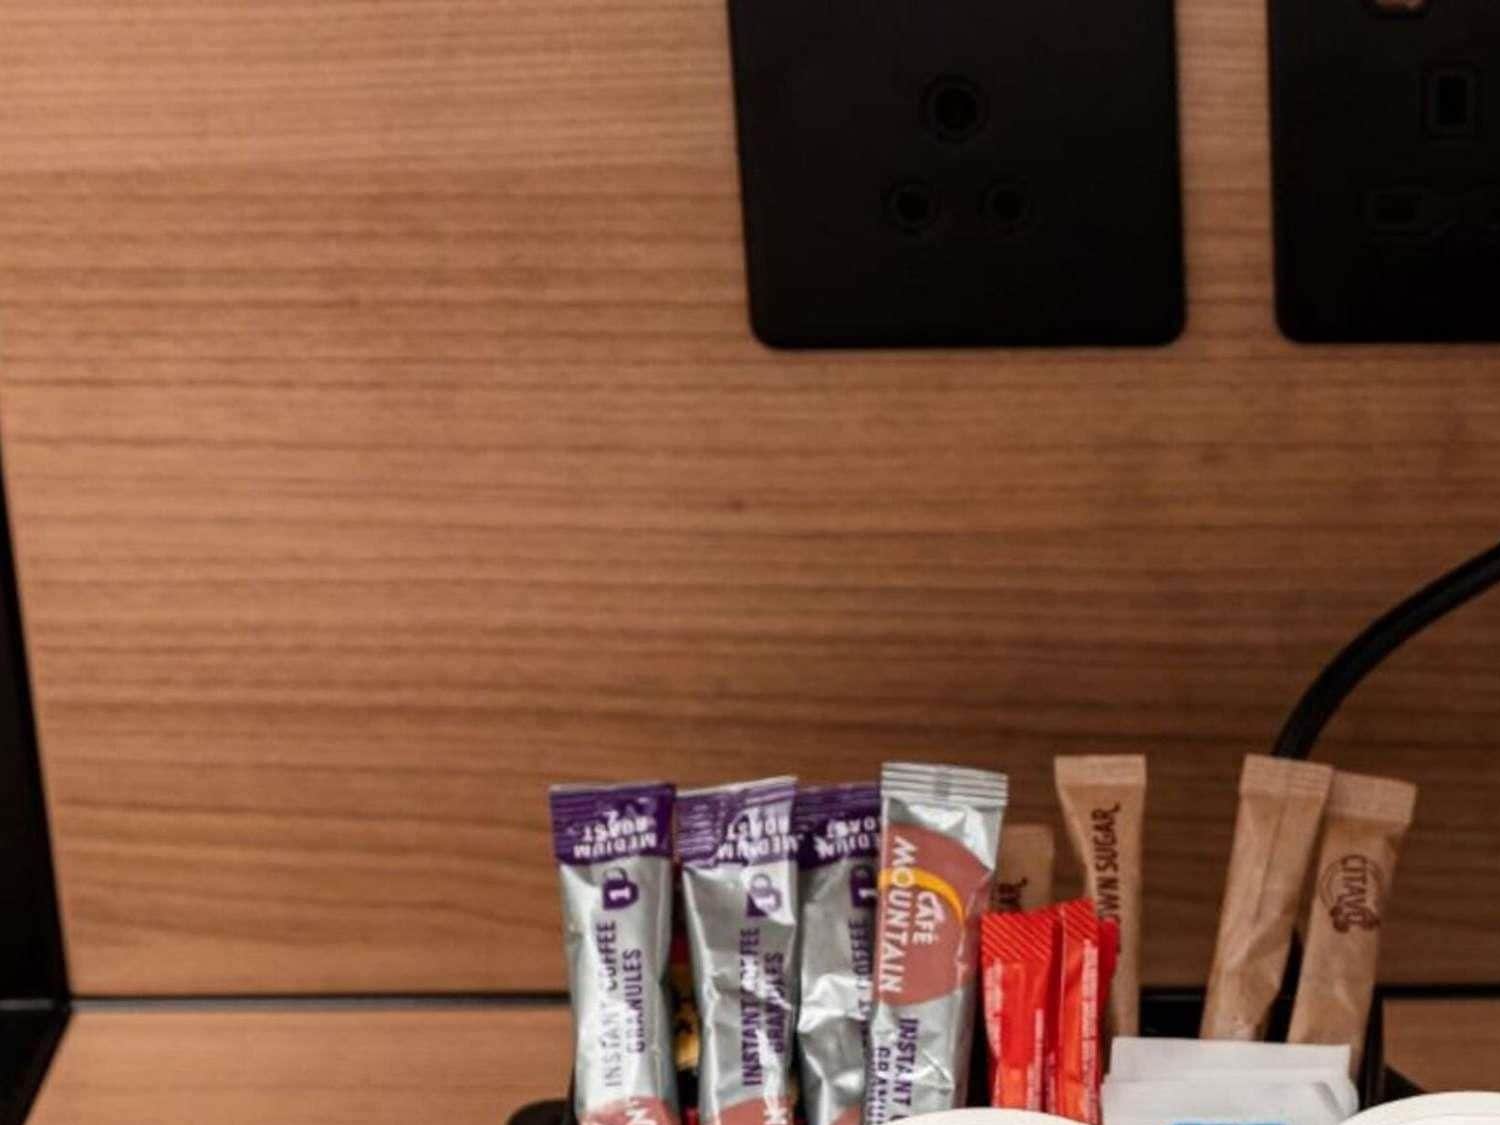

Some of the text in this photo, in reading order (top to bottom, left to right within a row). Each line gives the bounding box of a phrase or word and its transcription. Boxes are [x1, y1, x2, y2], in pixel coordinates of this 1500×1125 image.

[1091, 801, 1121, 872] SUGAR
[878, 834, 918, 994] MOUNTAIN
[893, 1017, 919, 1107] INSTANT
